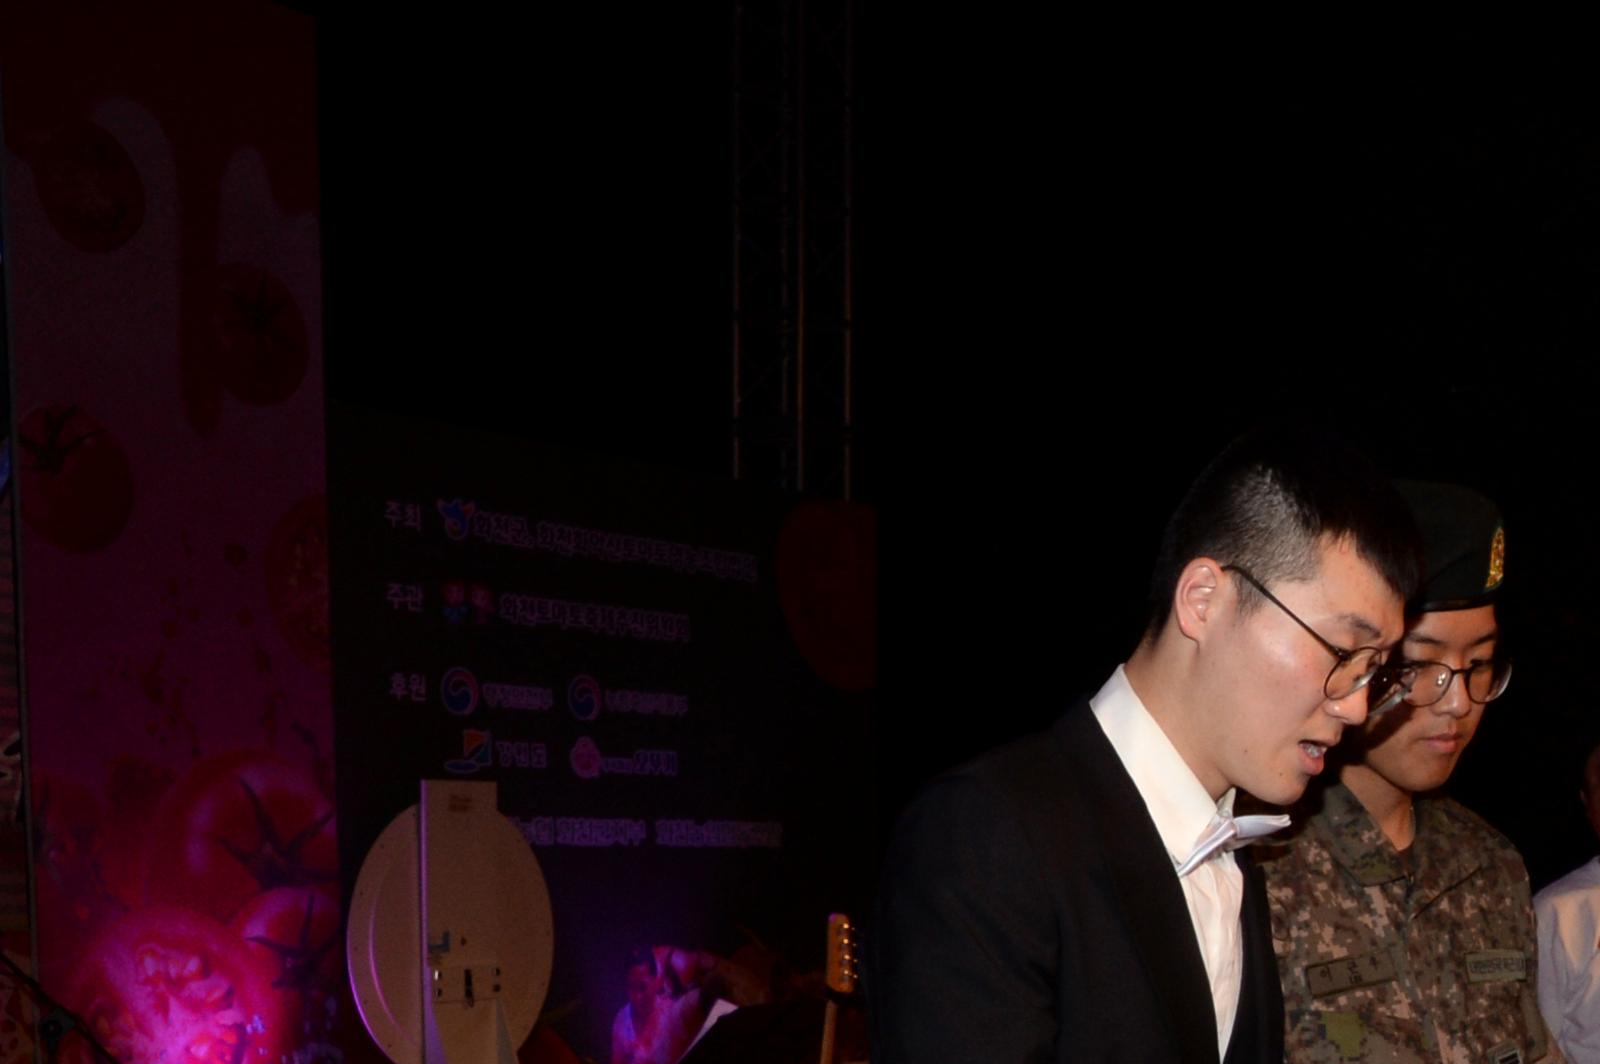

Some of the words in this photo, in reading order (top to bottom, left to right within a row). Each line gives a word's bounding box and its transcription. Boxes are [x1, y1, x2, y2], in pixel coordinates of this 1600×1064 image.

[384, 499, 422, 532] 주최
[384, 583, 425, 614] 주관
[389, 672, 428, 703] 후원
